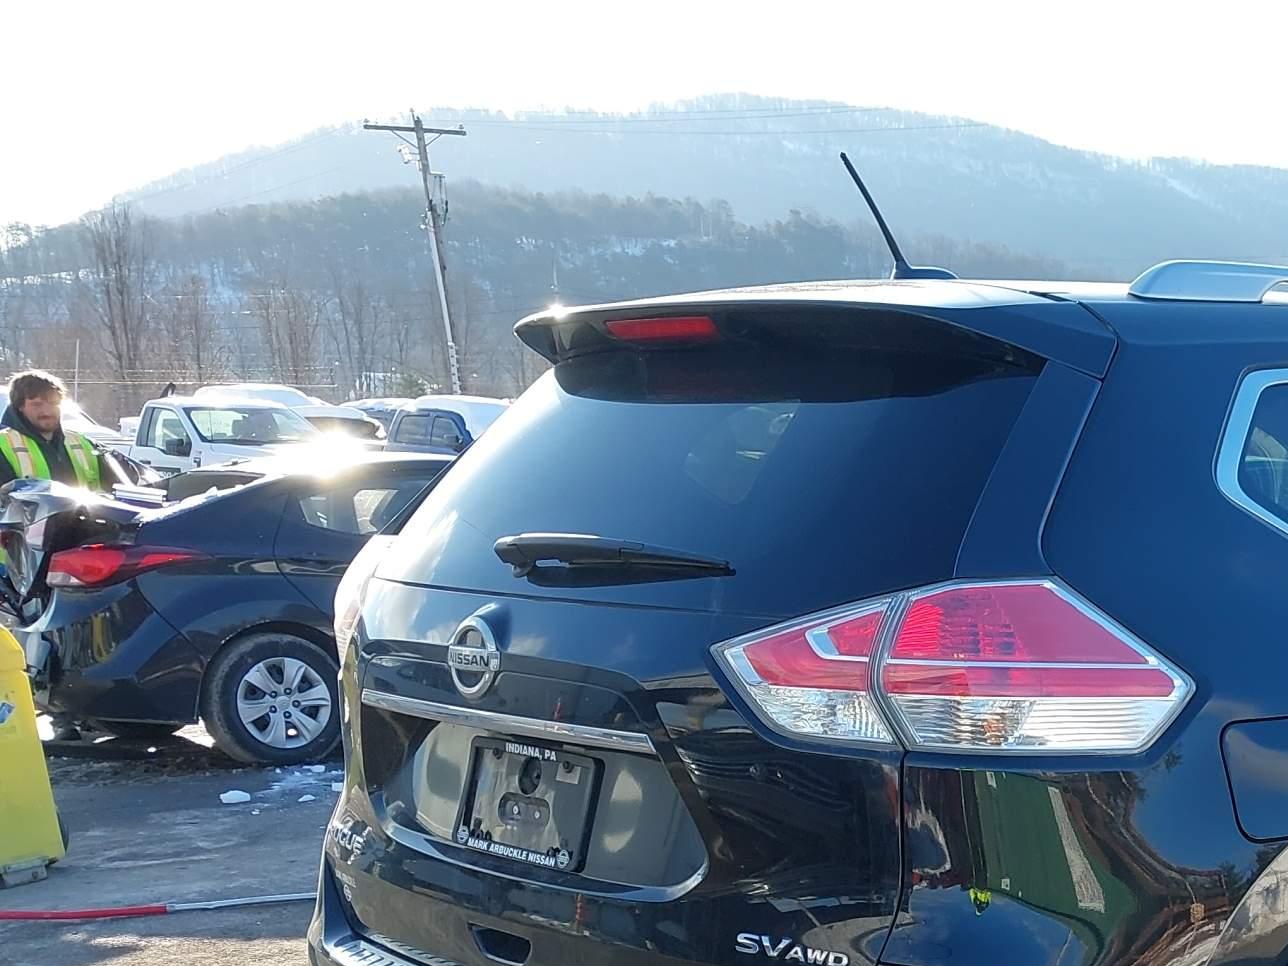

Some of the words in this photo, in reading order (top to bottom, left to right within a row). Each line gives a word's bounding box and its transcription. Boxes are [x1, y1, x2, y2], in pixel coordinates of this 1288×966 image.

[449, 651, 490, 668] NISSAN
[505, 741, 543, 761] INDIANA,
[544, 749, 557, 762] PA
[467, 837, 489, 851] MARK
[488, 842, 528, 861] ARBUCKLE
[527, 852, 556, 868] NISSAN
